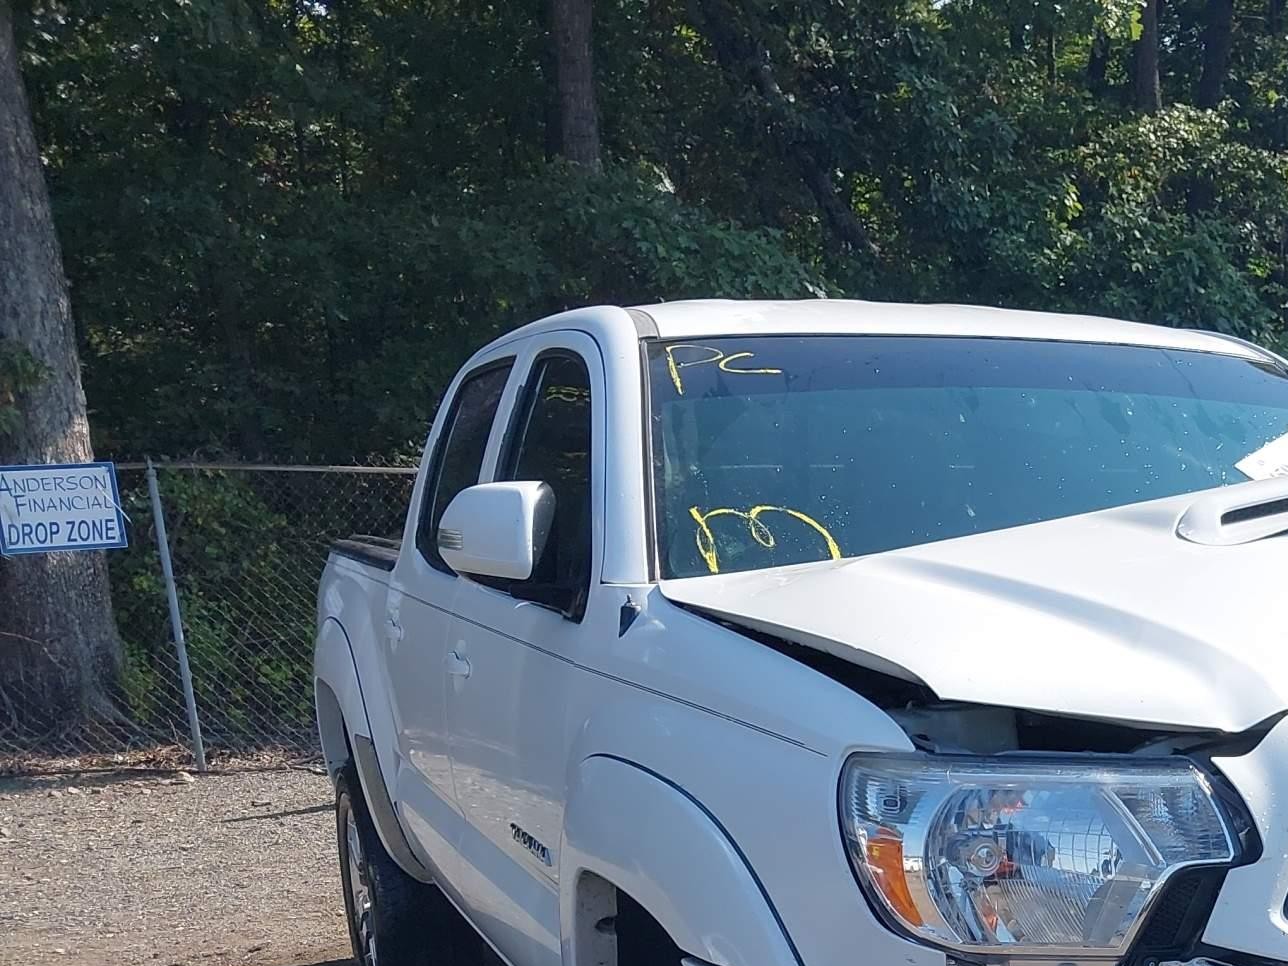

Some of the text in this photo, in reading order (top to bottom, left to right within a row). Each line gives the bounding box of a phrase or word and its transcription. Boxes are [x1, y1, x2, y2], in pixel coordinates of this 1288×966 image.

[0, 473, 107, 496] ANDERSON
[14, 494, 113, 517] FINANCIAL
[8, 518, 116, 546] DROP ZONE
